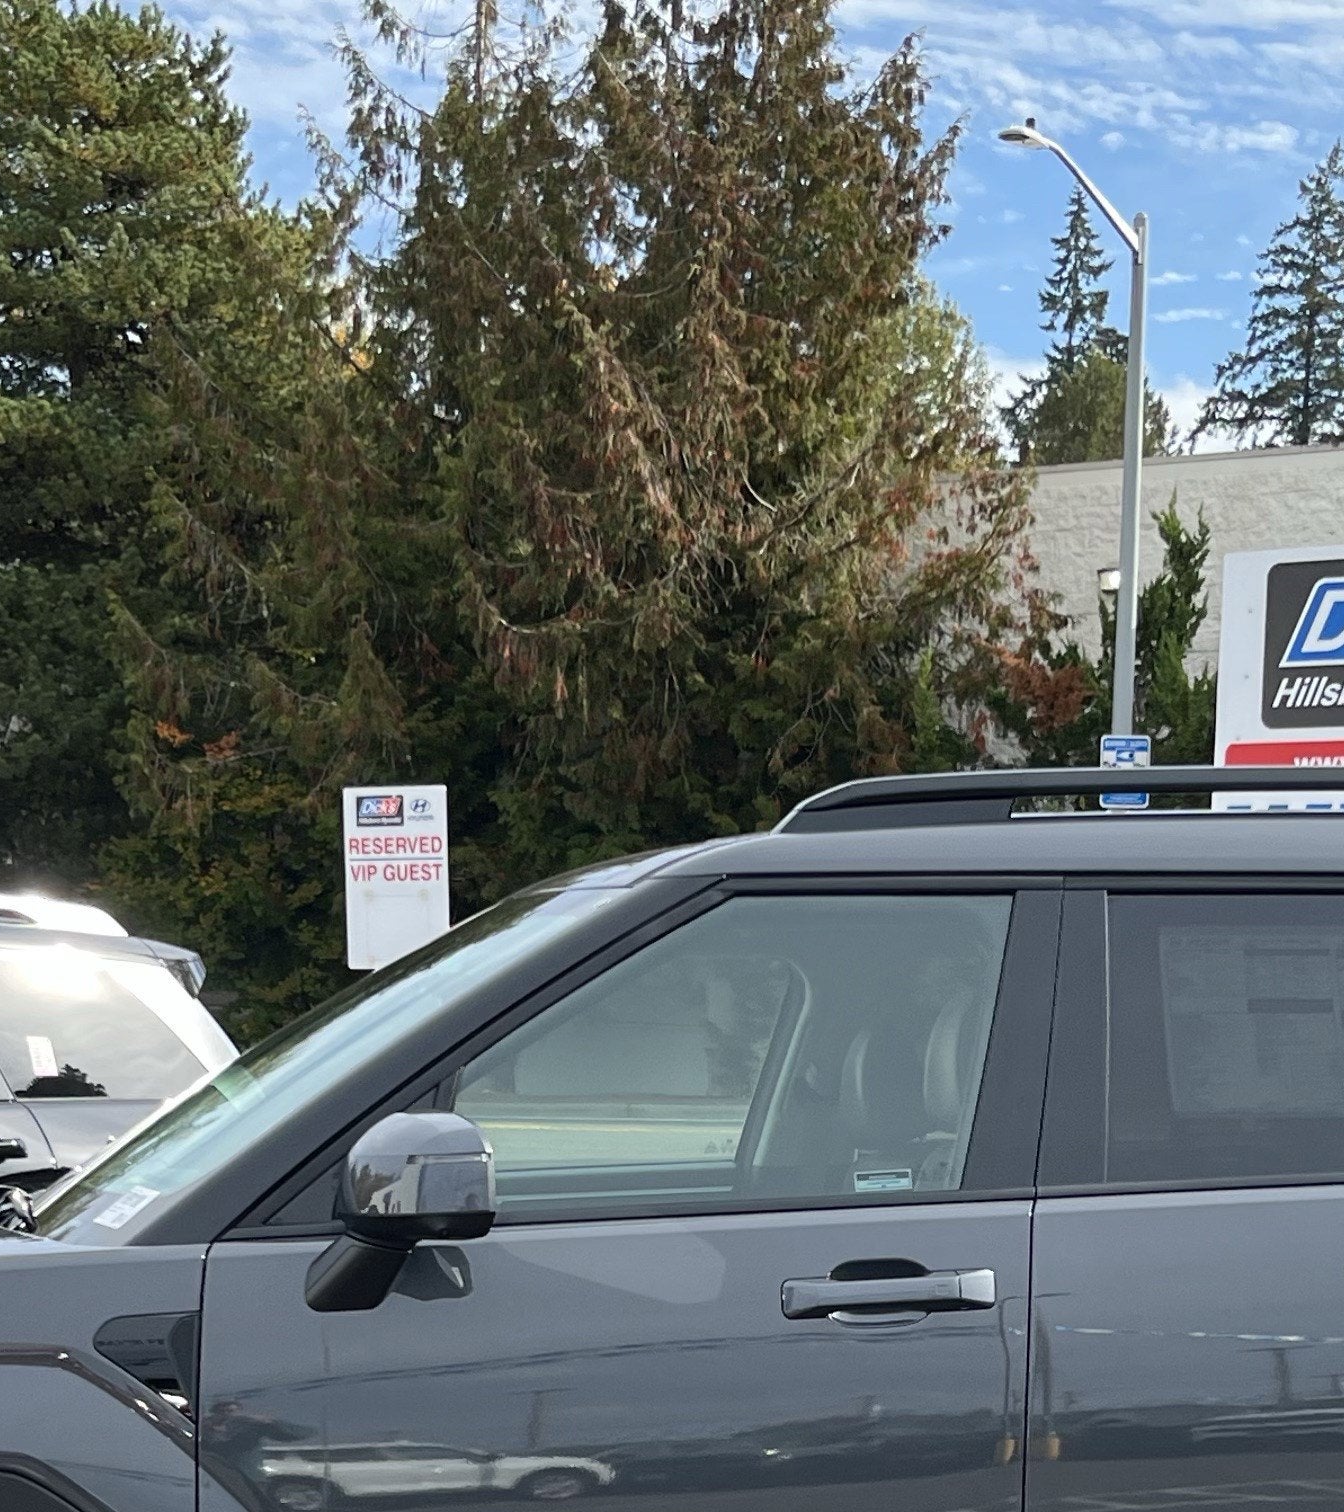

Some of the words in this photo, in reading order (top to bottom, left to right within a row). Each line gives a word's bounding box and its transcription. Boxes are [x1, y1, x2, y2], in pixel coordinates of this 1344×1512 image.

[348, 836, 443, 855] RESERVED
[350, 864, 377, 882] VIP
[383, 863, 443, 882] GUEST
